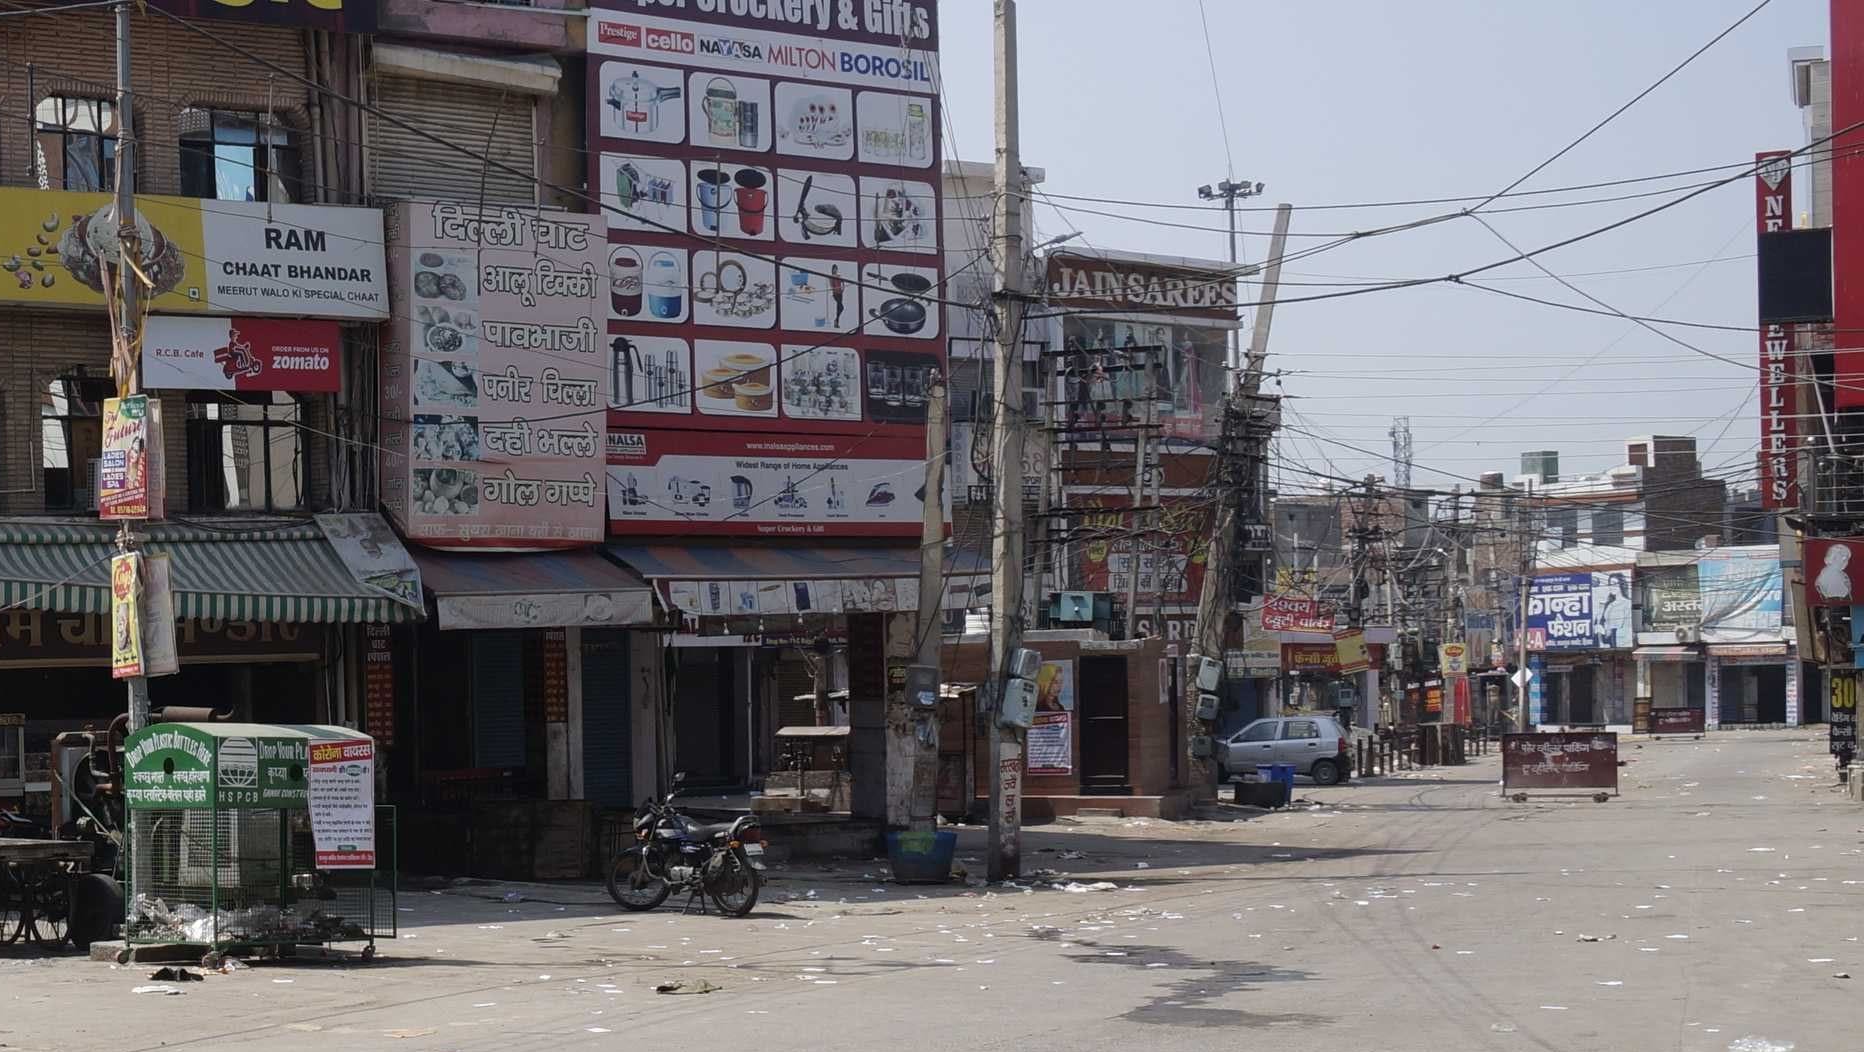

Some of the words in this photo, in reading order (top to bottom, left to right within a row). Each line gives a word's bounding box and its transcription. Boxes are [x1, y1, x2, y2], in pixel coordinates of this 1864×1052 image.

[837, 3, 858, 31] &
[864, 1, 931, 40] Gifts
[599, 24, 638, 41] Prestige
[647, 35, 694, 52] cello
[699, 38, 763, 61] NAYASA
[768, 44, 836, 72] MILTON
[840, 52, 930, 82] BOROSIL
[264, 227, 327, 253] RAM
[221, 261, 282, 279] CHAAT
[286, 264, 373, 283] BHANDAR
[483, 264, 537, 307] आलू
[1050, 267, 1123, 302] JAIN
[1126, 272, 1237, 312] SAREES
[216, 285, 259, 297] MEERUT
[260, 287, 290, 298] WALO
[291, 289, 303, 299] KI
[303, 289, 345, 301] SPECIAL
[346, 292, 380, 302] CHAAT
[155, 348, 183, 359] R.C.B.
[184, 349, 205, 360] Cafe
[271, 355, 330, 371] zomato
[482, 365, 533, 403] पनीर
[483, 417, 533, 455] दही
[482, 468, 541, 506] गोल
[1831, 677, 1854, 709] 30
